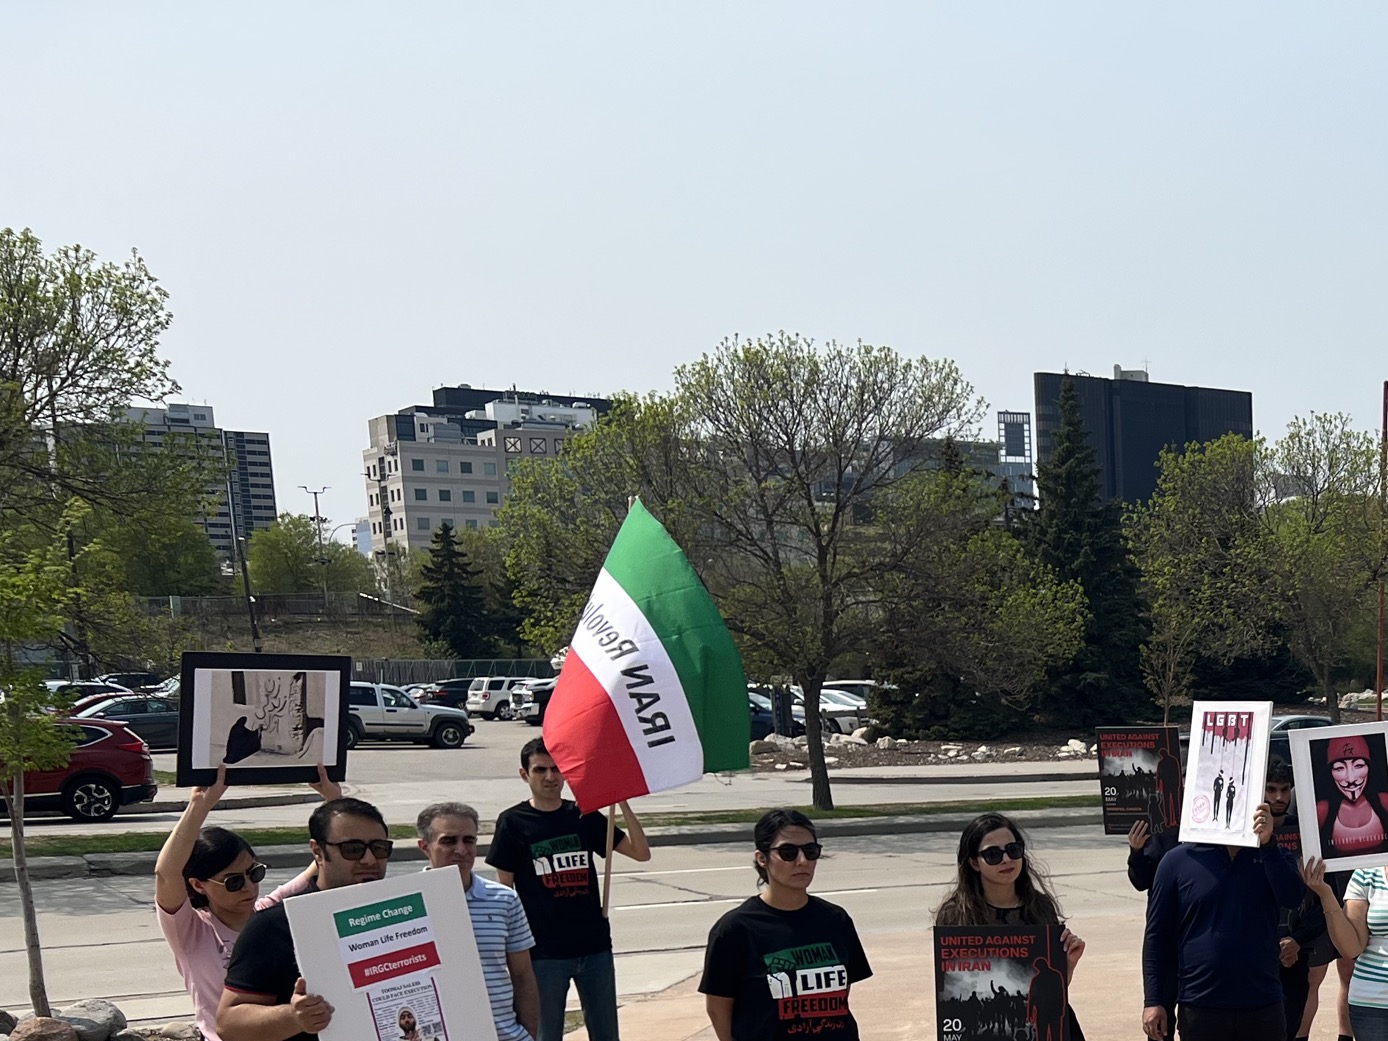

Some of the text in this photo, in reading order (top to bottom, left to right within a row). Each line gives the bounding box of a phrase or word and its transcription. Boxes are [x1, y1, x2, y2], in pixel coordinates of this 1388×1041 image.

[1206, 714, 1249, 726] LGBT
[1104, 787, 1117, 796] 20
[556, 854, 587, 868] LIFE
[348, 905, 413, 928] Regime Change
[348, 926, 428, 952] Woman Life Freedom
[940, 935, 1036, 946] UNITED AGAINST
[790, 945, 838, 968] WOMAN
[941, 947, 1029, 959] EXECUTIONS
[364, 953, 427, 977] #IRGCterrorists
[942, 960, 992, 972] IN IRAN
[800, 970, 846, 992] LIFE
[783, 997, 848, 1014] FREEDOM
[942, 1018, 962, 1032] 20
[943, 1034, 962, 1041] MAY
